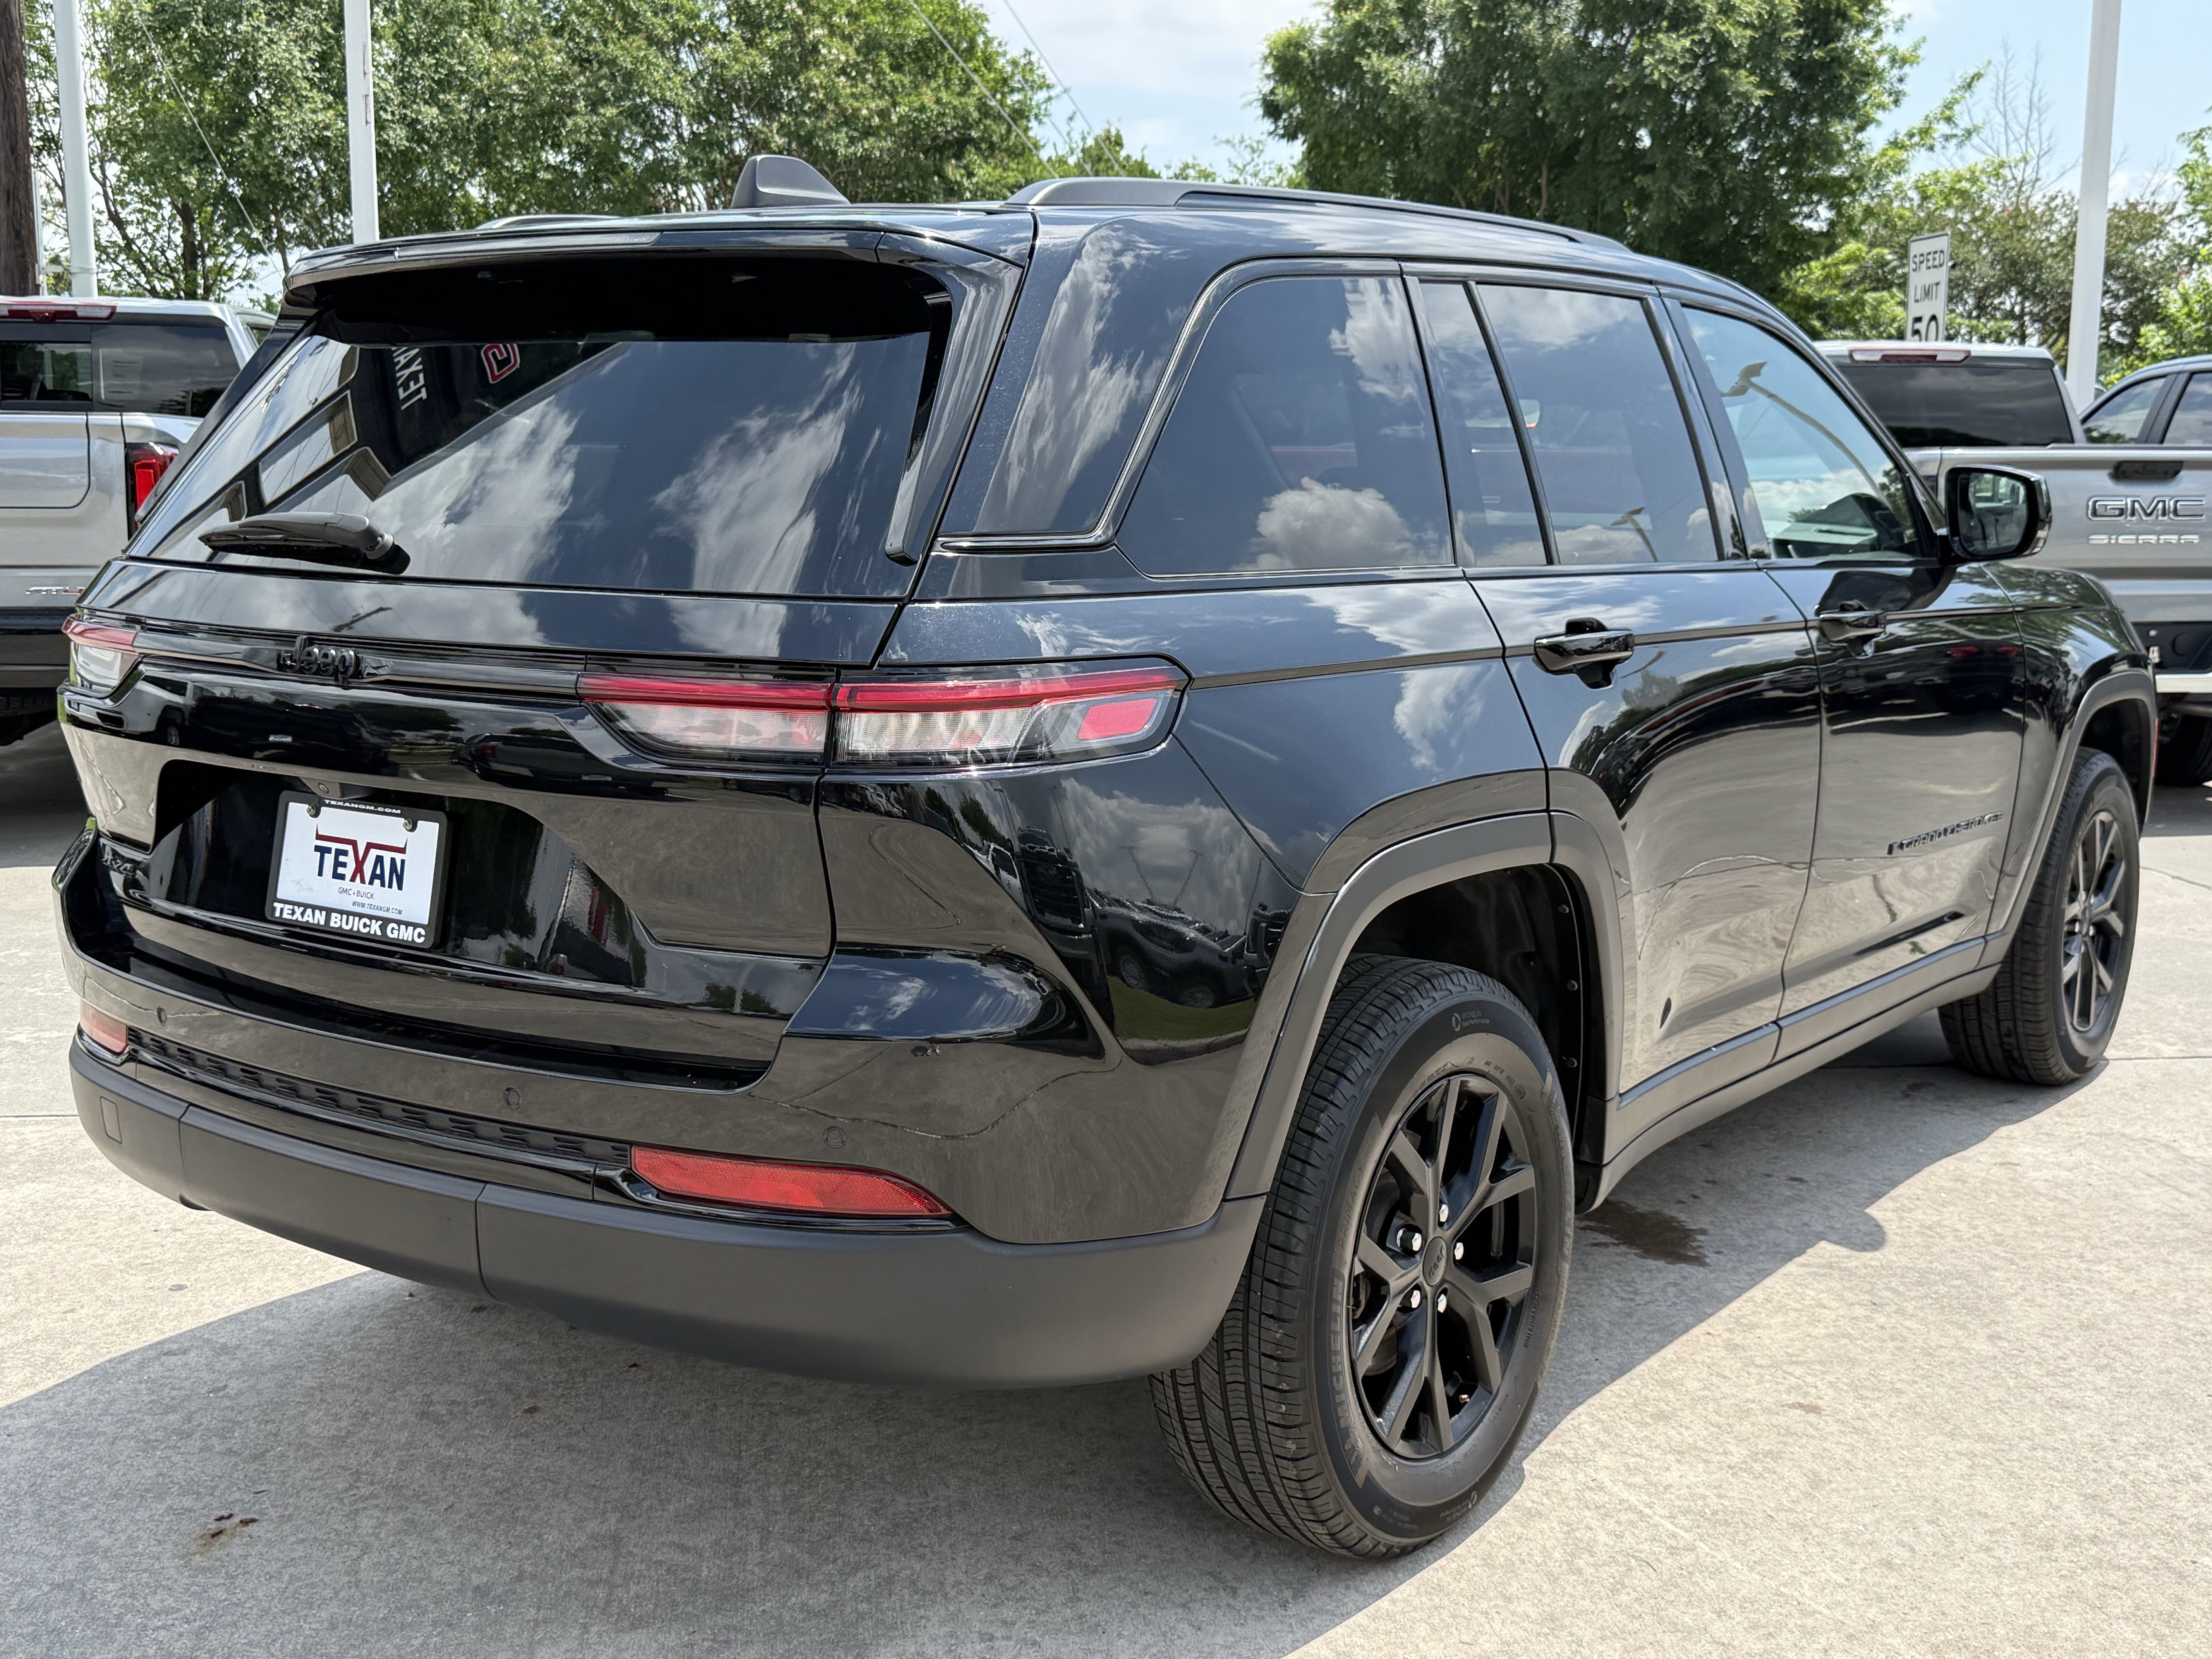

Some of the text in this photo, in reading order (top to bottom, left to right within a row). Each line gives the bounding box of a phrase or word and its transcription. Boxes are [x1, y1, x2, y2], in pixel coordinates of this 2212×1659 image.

[1912, 250, 1945, 272] SPEED
[1914, 282, 1940, 303] LIMIT
[1911, 313, 1939, 342] 50
[2087, 495, 2206, 521] GMC
[2088, 534, 2200, 544] SIERRA
[279, 635, 357, 685] Jeep
[324, 799, 401, 814] TEXANGM.COM
[314, 833, 407, 891] TEXAN
[338, 887, 375, 900] GMC BUICK
[352, 900, 403, 915] WWW.TEXANGM.COM
[273, 902, 426, 943] TEXAN BUICK GMC
[1338, 1166, 1364, 1248] PRIMACY
[1330, 1277, 1350, 1429] MICHELIN
